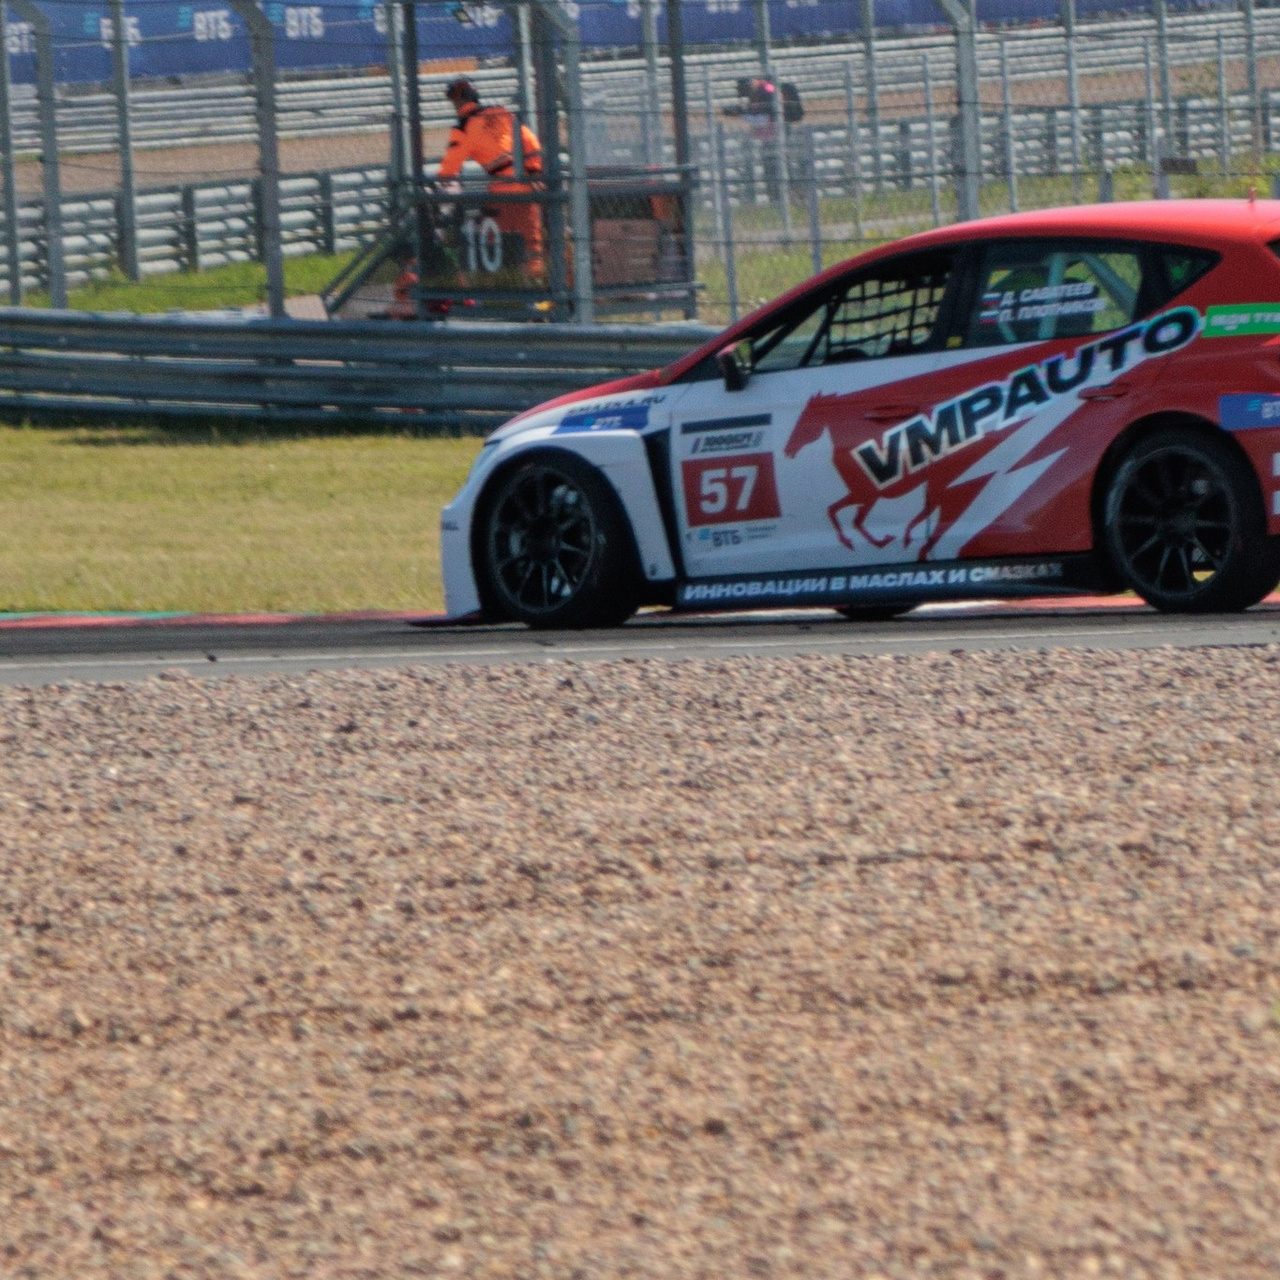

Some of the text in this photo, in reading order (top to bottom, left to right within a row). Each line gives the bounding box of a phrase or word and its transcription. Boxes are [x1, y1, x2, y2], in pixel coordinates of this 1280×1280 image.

[193, 9, 233, 41] ВТБ
[284, 6, 325, 38] ВТБ
[460, 217, 503, 272] 10
[853, 307, 1199, 487] VMPAUTO
[700, 464, 759, 515] 57
[712, 529, 743, 548] ВТБ
[684, 578, 827, 601] ИННОВАЦИИ
[829, 576, 847, 592] В
[850, 570, 944, 590] МАСЛАХ
[948, 568, 967, 584] И
